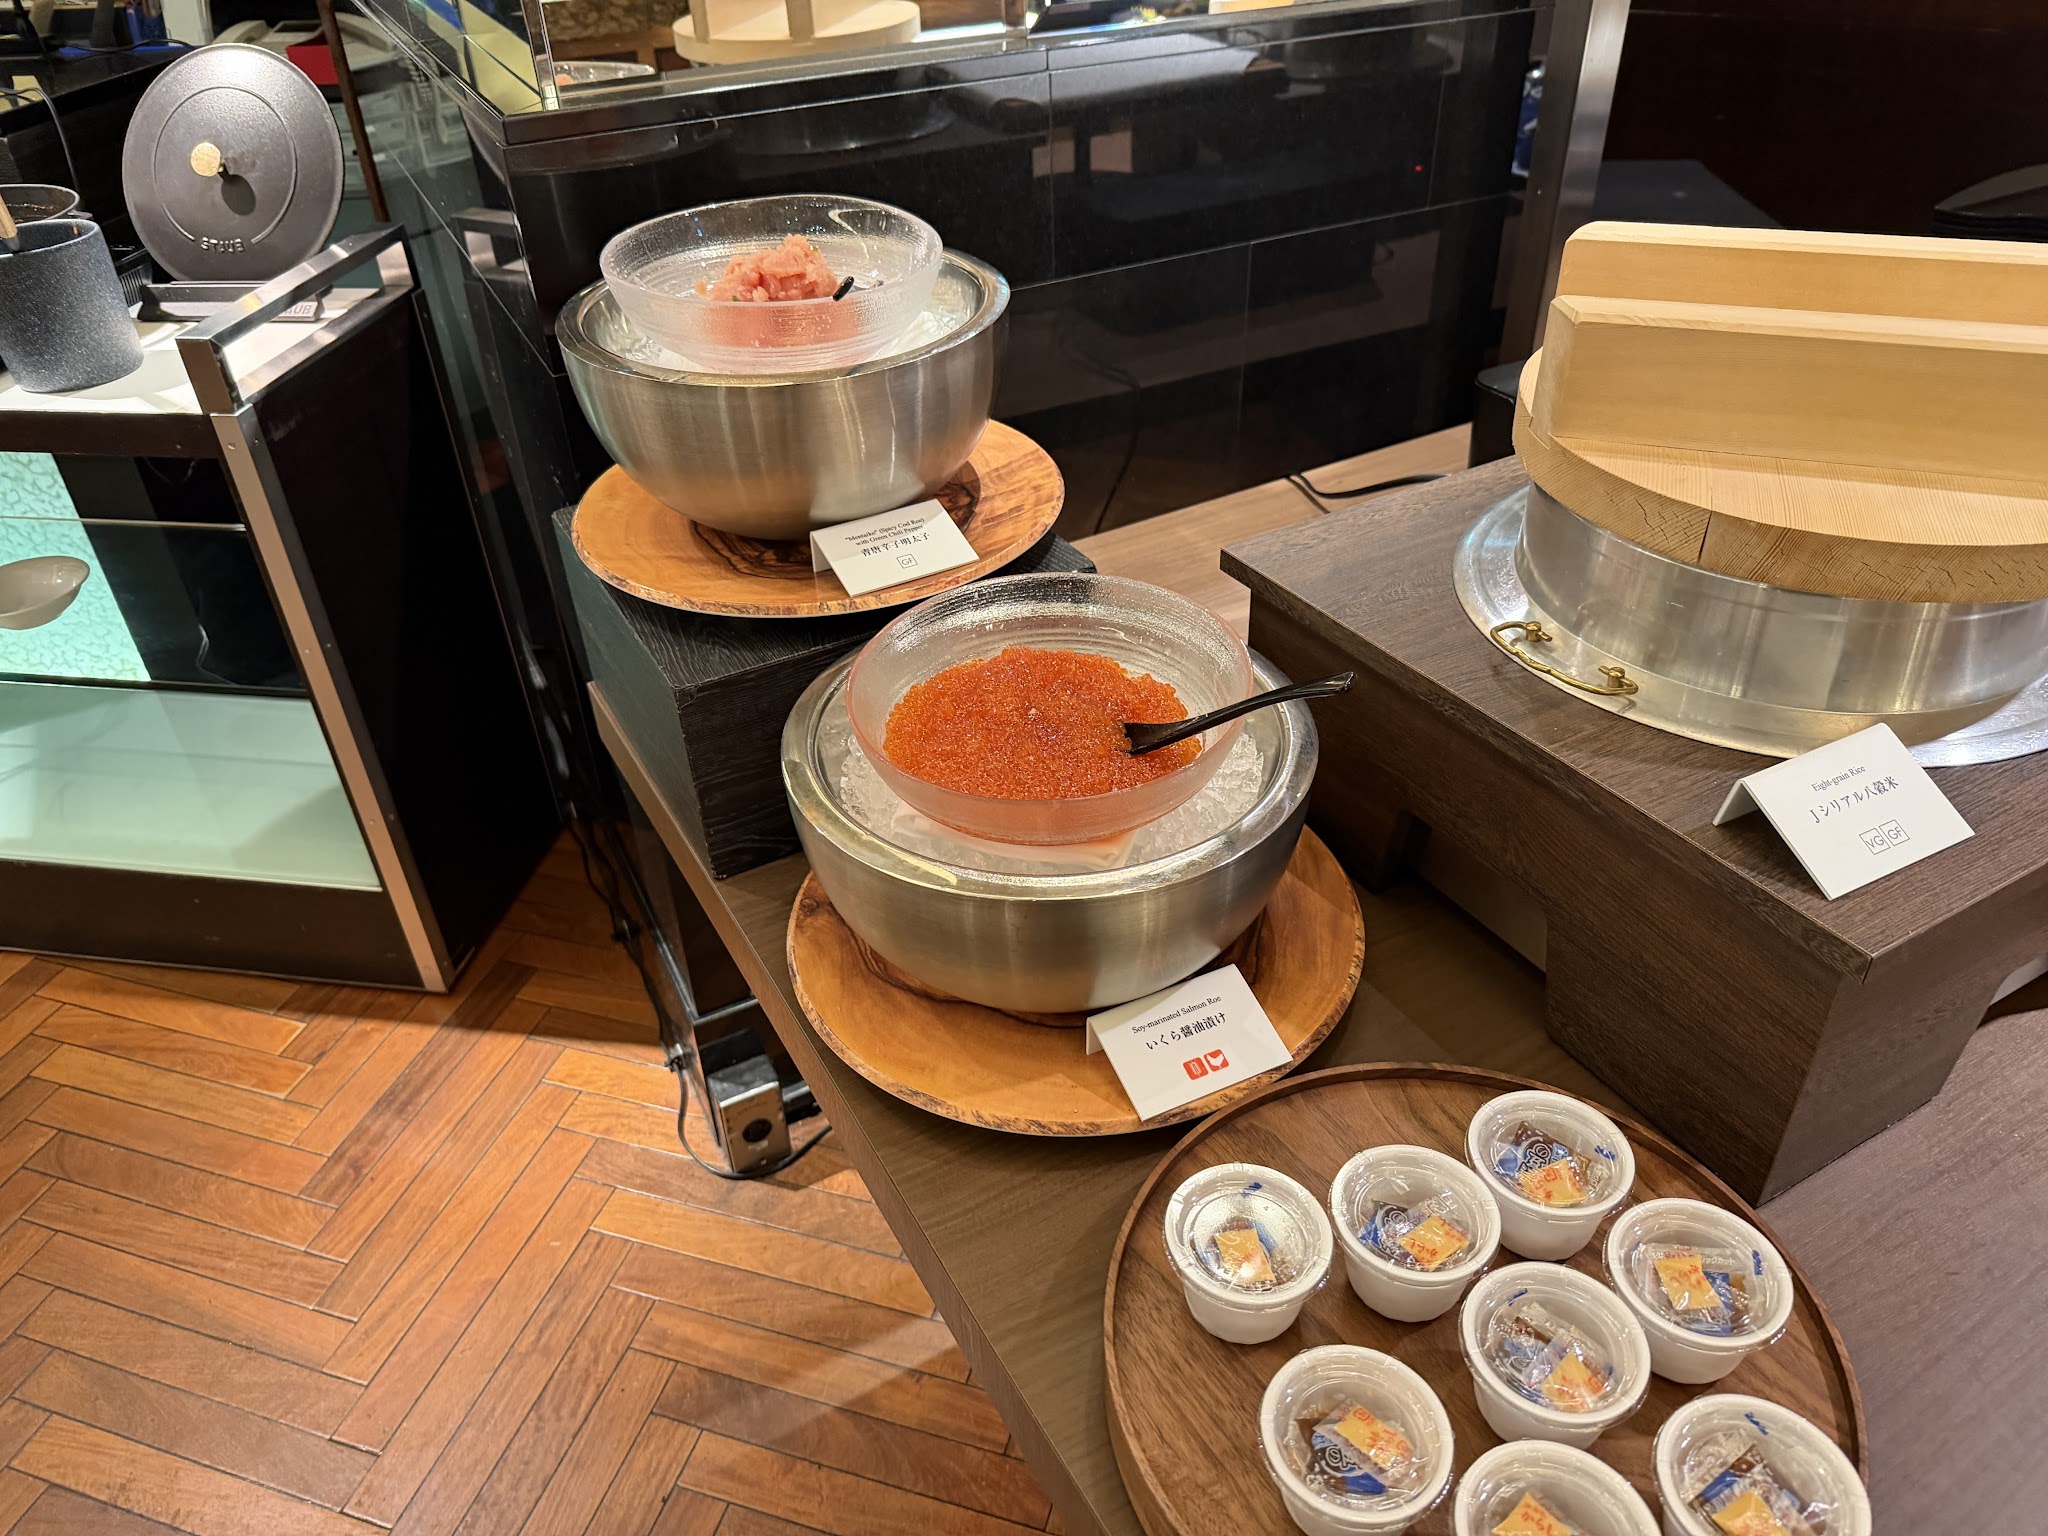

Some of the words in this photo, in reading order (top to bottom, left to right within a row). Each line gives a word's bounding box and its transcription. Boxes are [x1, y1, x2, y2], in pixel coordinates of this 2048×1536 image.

[200, 236, 246, 253] STAUB
[870, 535, 888, 543] Green
[903, 525, 923, 533] Pepper
[901, 558, 914, 566] GF
[1811, 771, 1850, 792] Eight-grain
[1847, 765, 1866, 777] Rice
[1887, 826, 1902, 840] GF
[1865, 835, 1885, 849] VG
[1131, 1010, 1181, 1034] Soy-marinated
[1180, 1001, 1208, 1015] Salmon
[1207, 995, 1222, 1005] Roe
[1145, 1012, 1227, 1050] いくら醤油漬け
